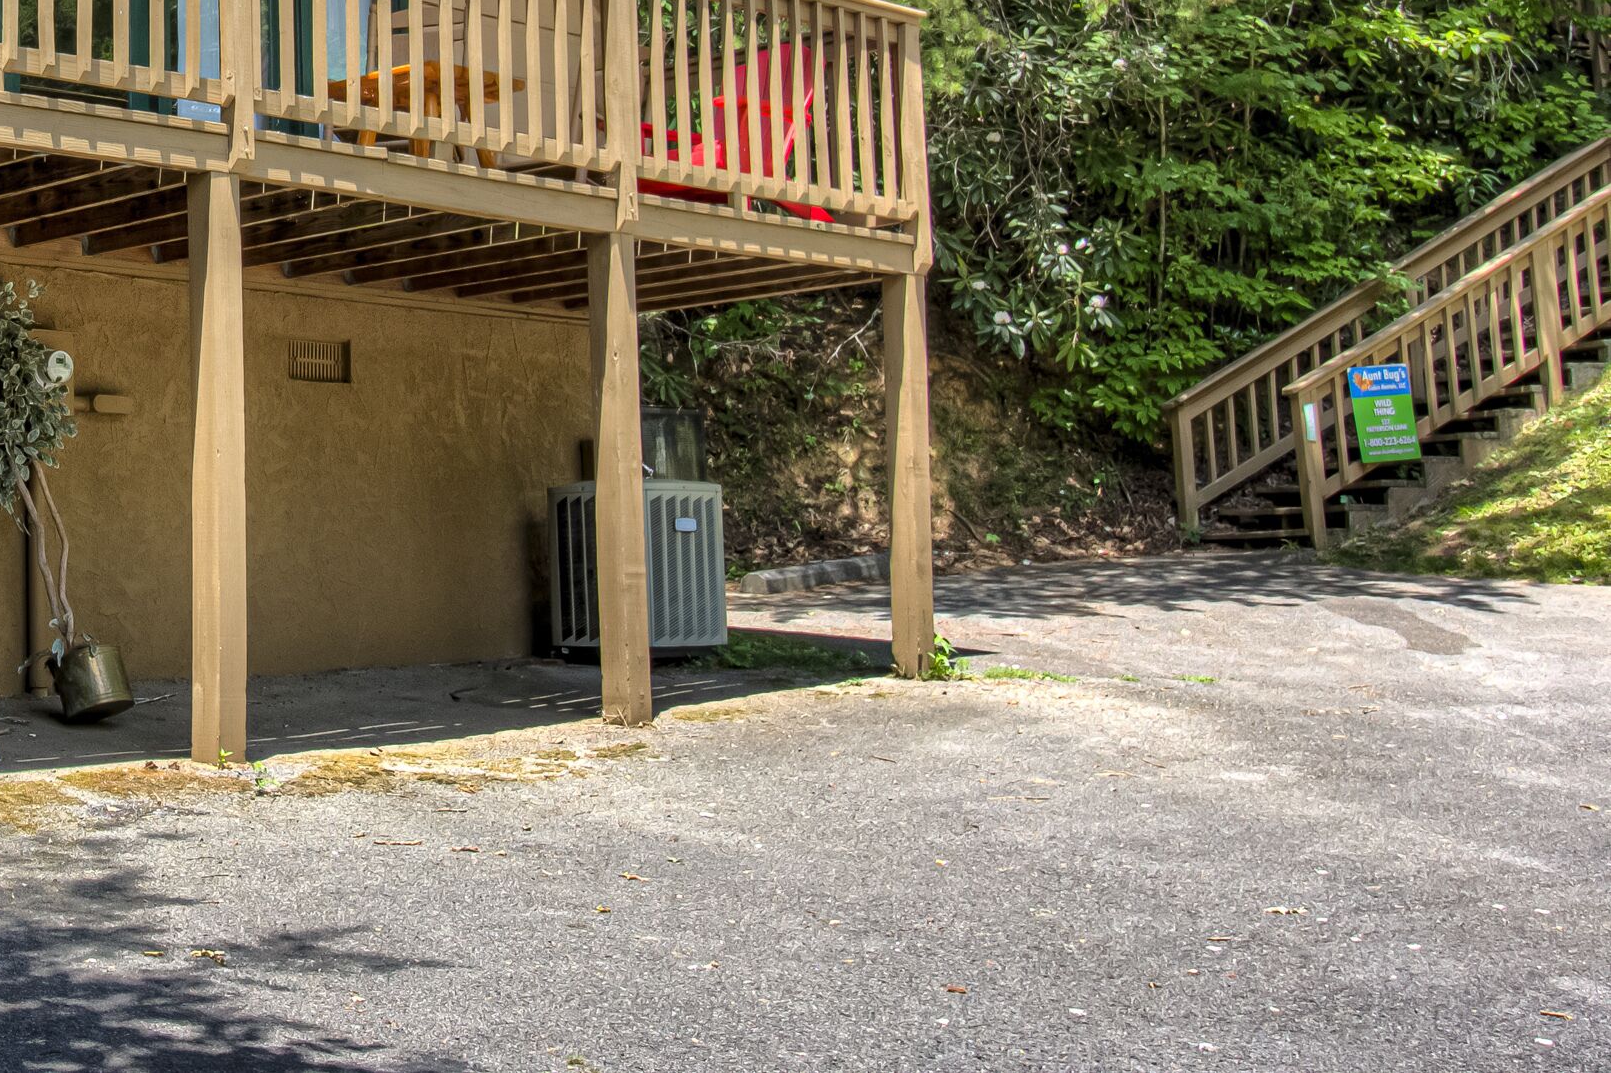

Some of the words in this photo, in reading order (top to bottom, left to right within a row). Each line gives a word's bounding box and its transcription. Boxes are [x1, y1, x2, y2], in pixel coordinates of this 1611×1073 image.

[1362, 370, 1381, 380] Aunt
[1383, 368, 1406, 382] Bug's
[1374, 399, 1392, 408] WILD
[1374, 407, 1396, 416] THING
